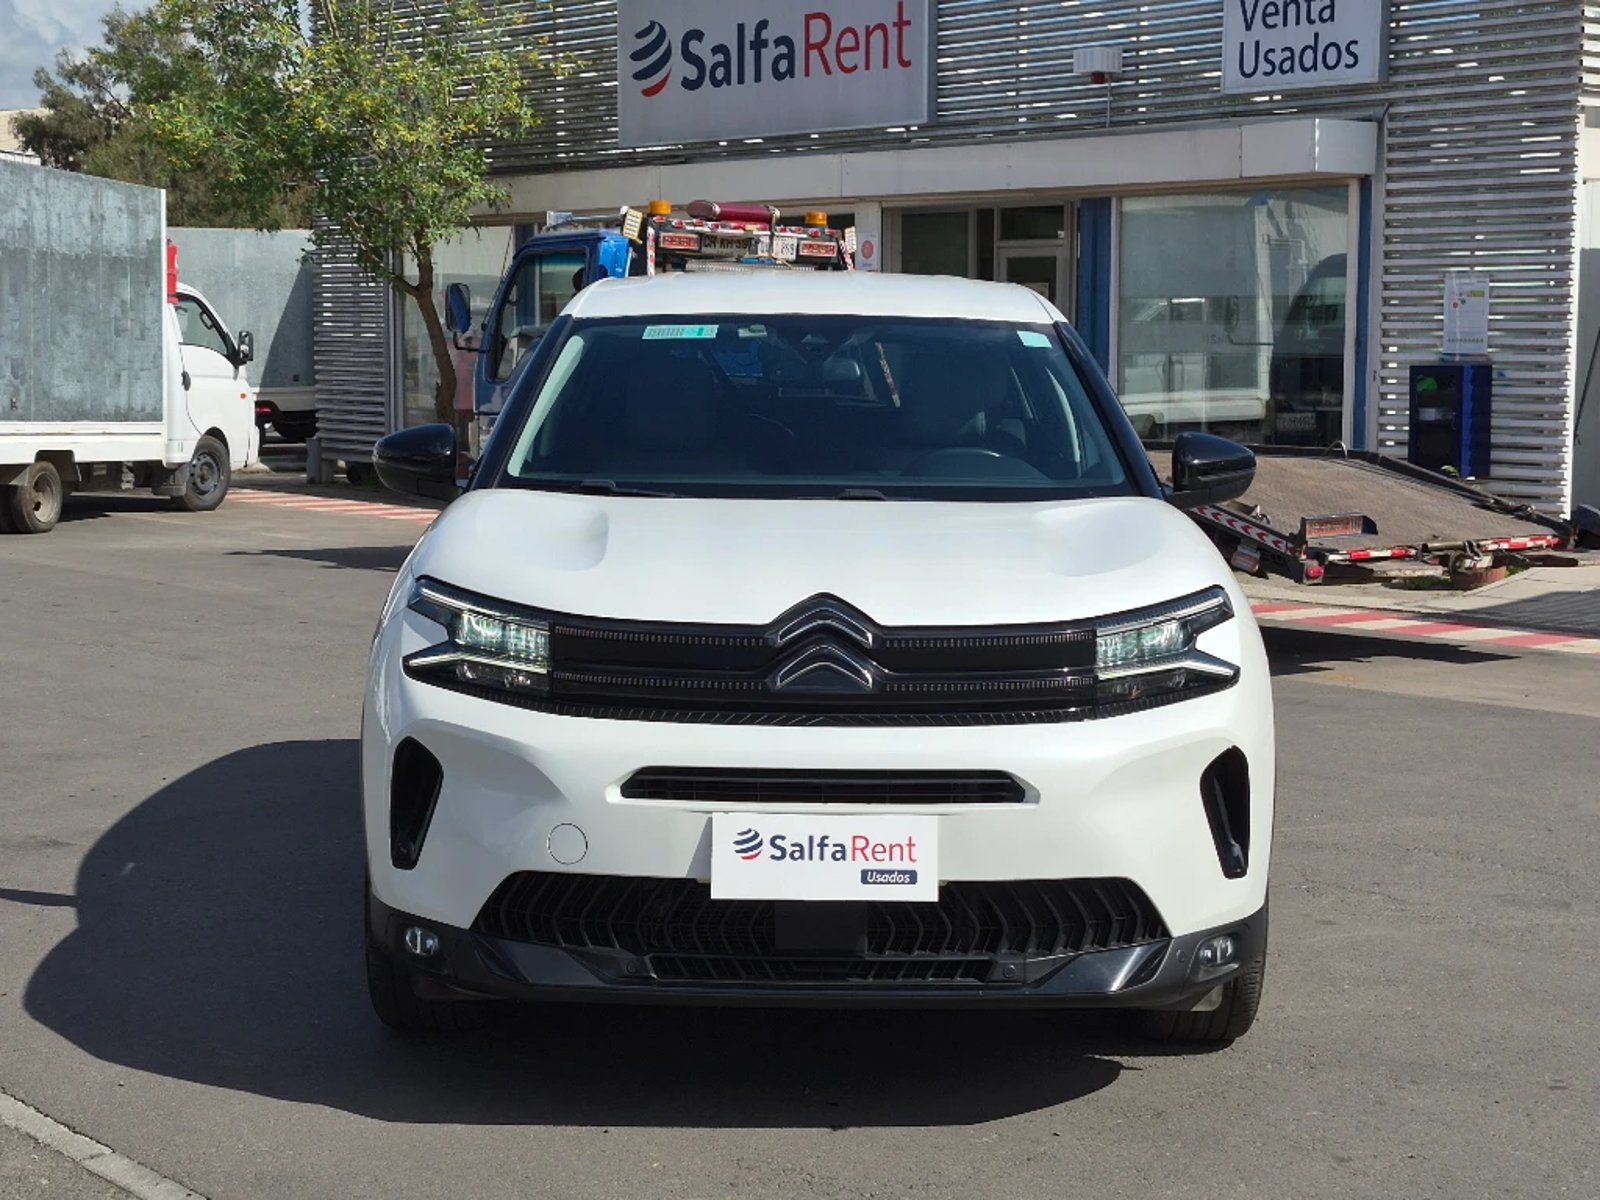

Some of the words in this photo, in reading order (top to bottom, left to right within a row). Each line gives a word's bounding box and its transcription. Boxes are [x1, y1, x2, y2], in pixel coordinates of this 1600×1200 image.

[1239, 0, 1336, 32] Venta
[680, 0, 912, 91] SalfaRent
[1238, 31, 1359, 79] Usados
[769, 834, 918, 863] SalfaRent
[866, 870, 911, 884] Usados
